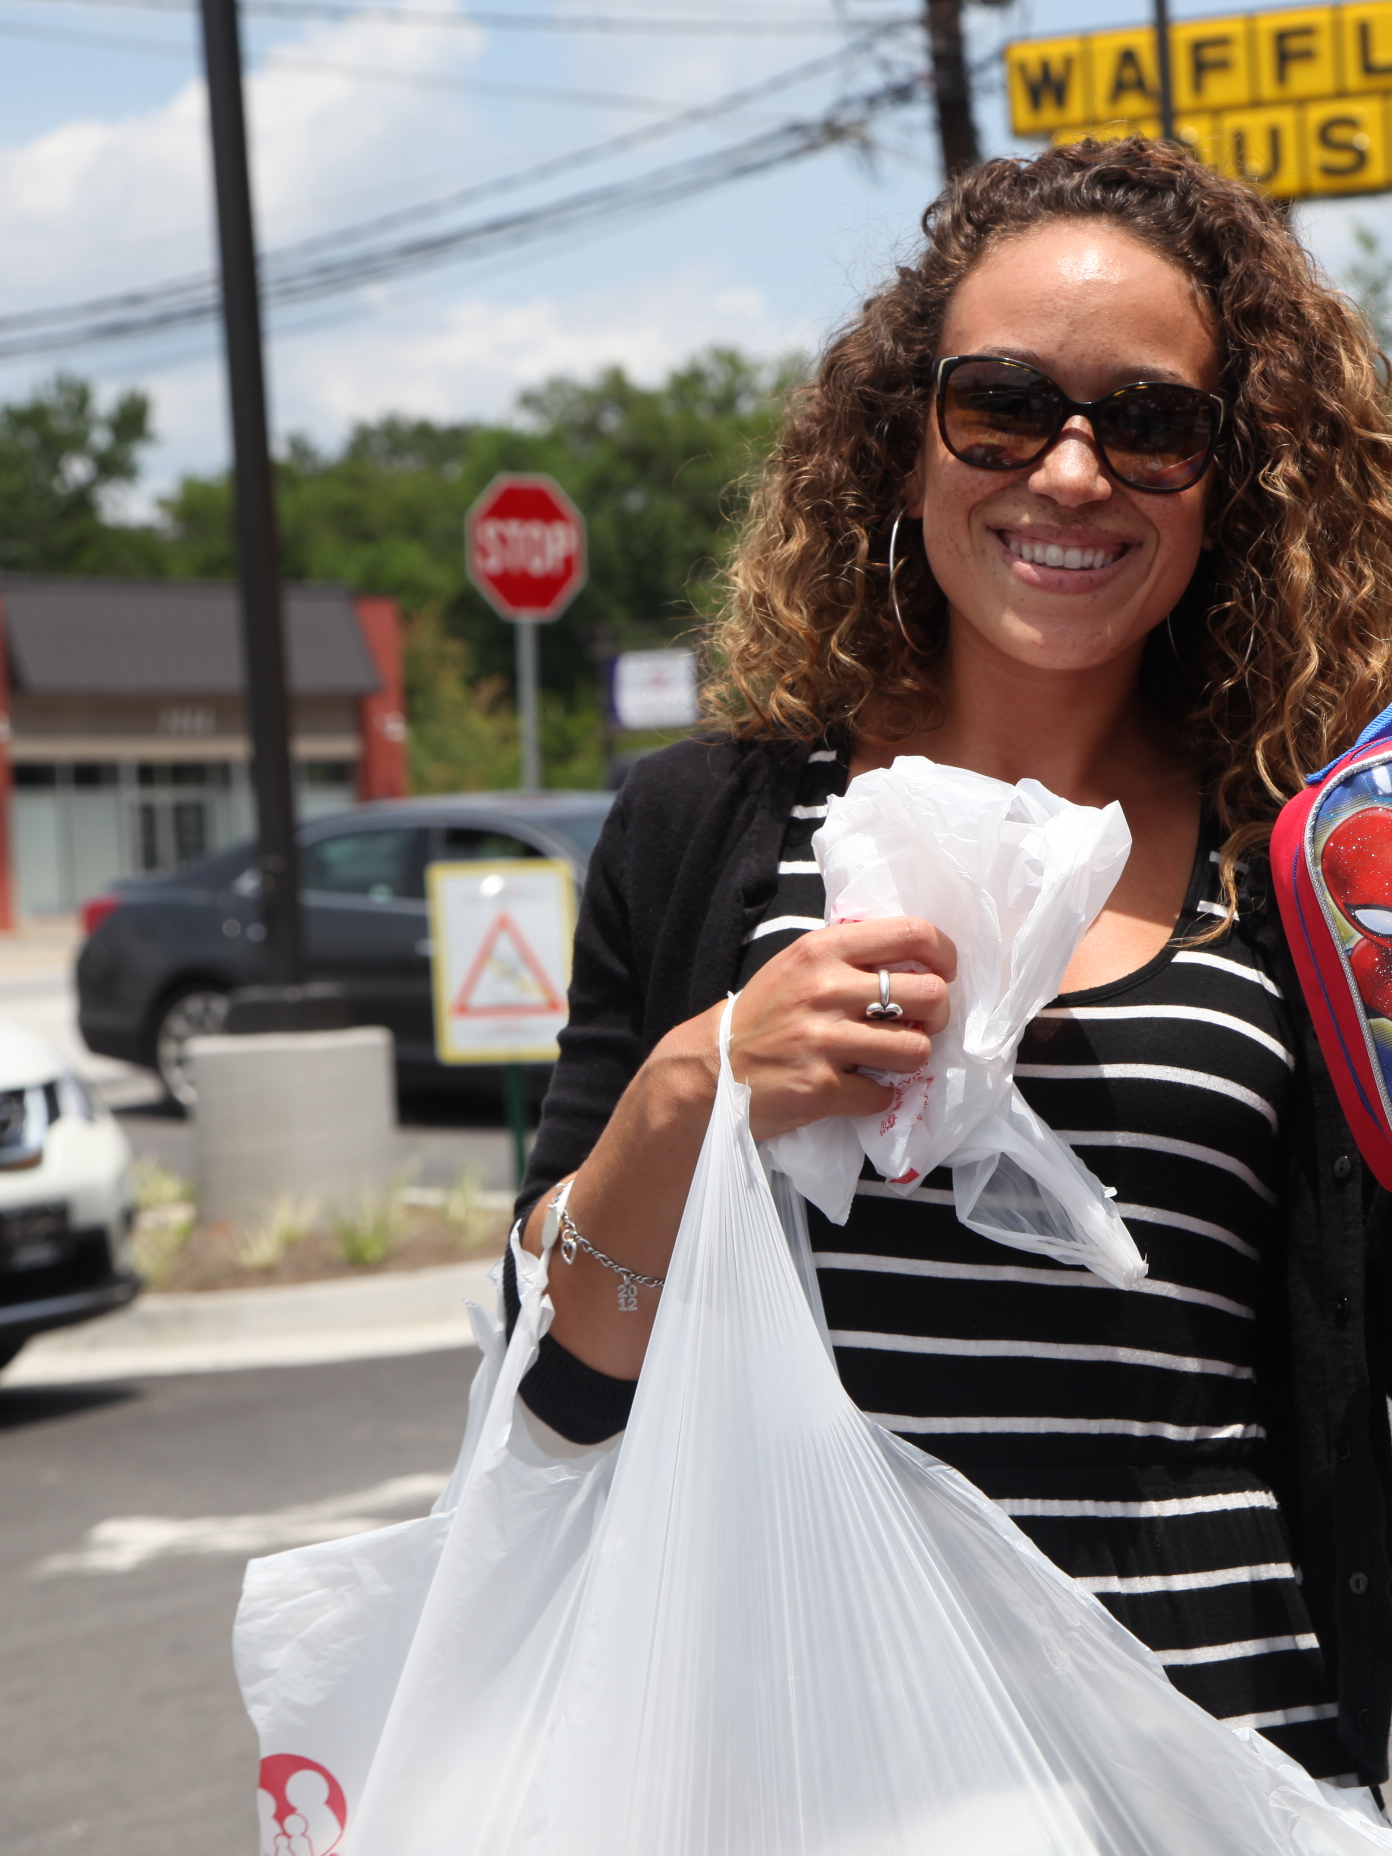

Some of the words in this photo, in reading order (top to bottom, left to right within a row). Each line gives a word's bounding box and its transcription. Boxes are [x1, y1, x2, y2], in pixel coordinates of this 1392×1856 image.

[475, 518, 578, 578] STOP
[617, 1285, 638, 1298] 20
[618, 1298, 638, 1311] 12
